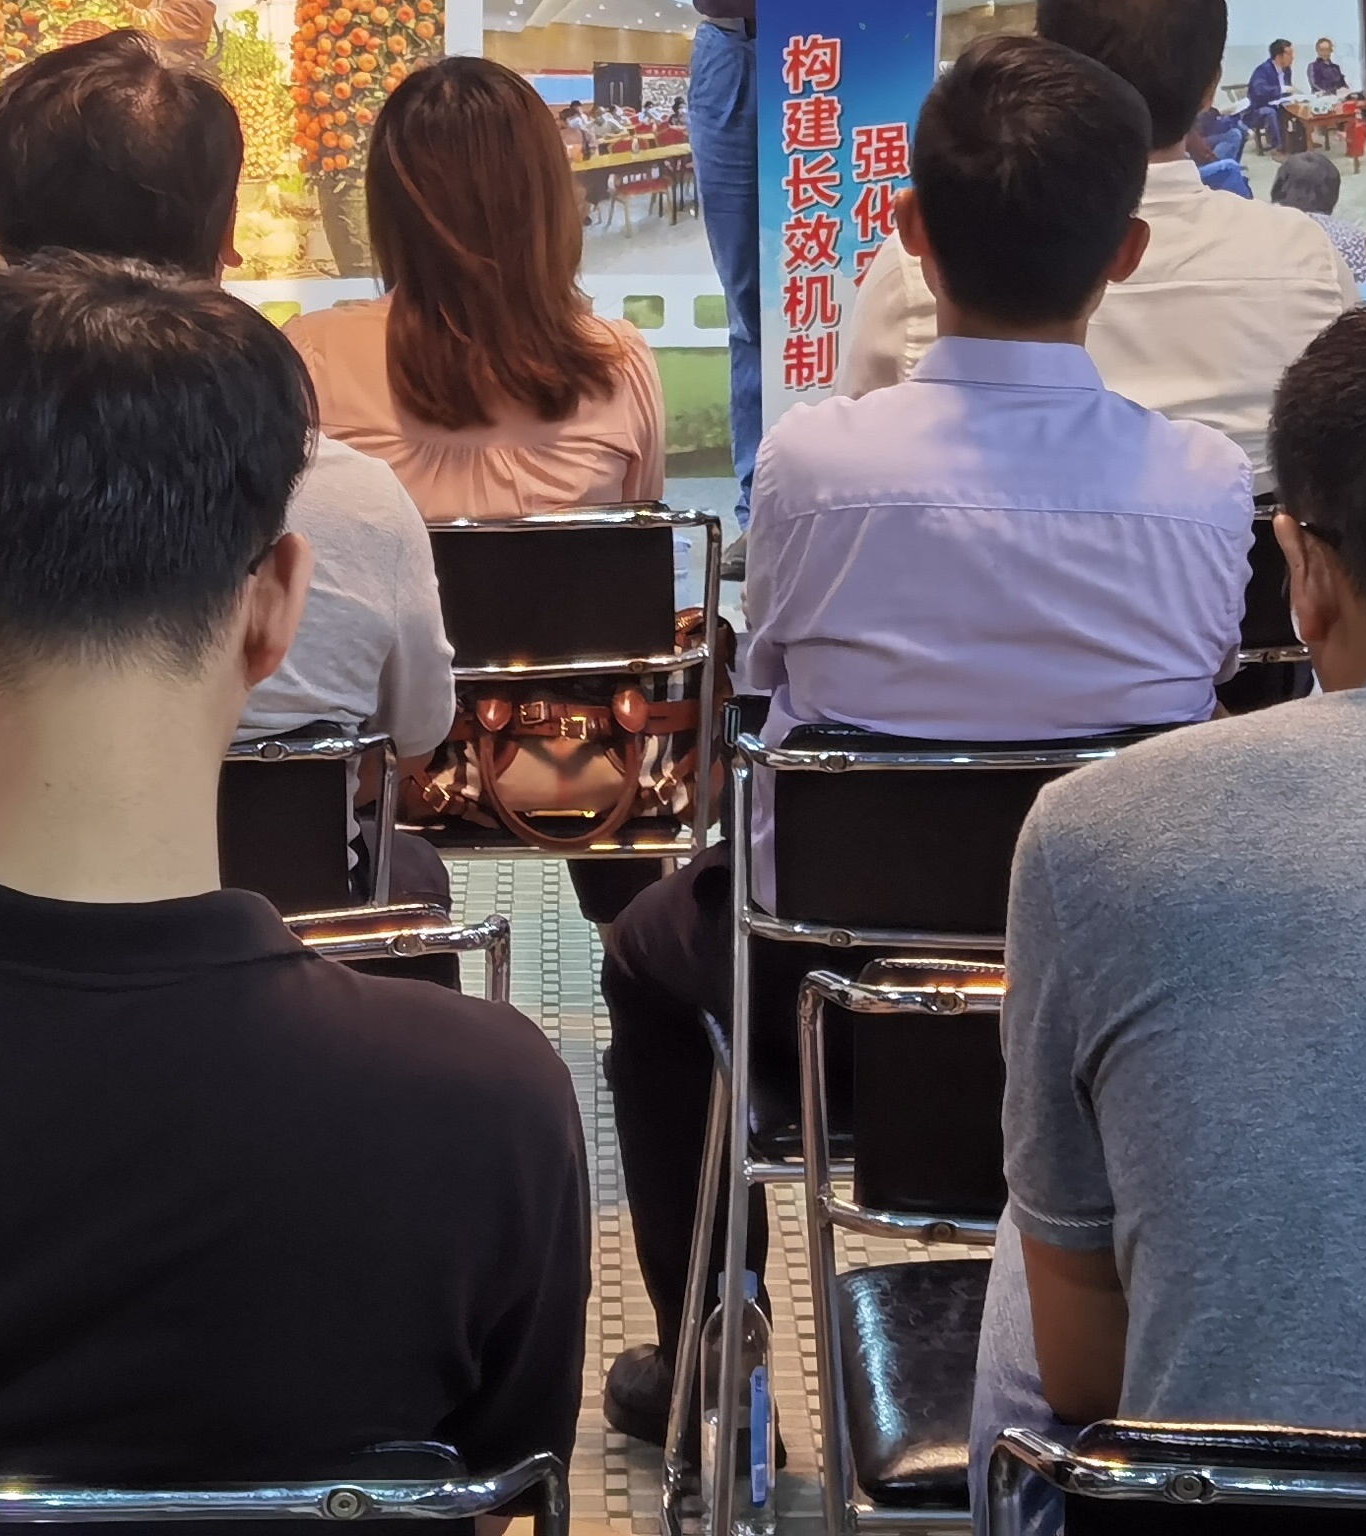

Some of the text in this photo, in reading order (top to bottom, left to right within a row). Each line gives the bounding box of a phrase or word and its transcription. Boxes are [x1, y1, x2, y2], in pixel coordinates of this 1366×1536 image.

[782, 34, 842, 390] 构建长效机制
